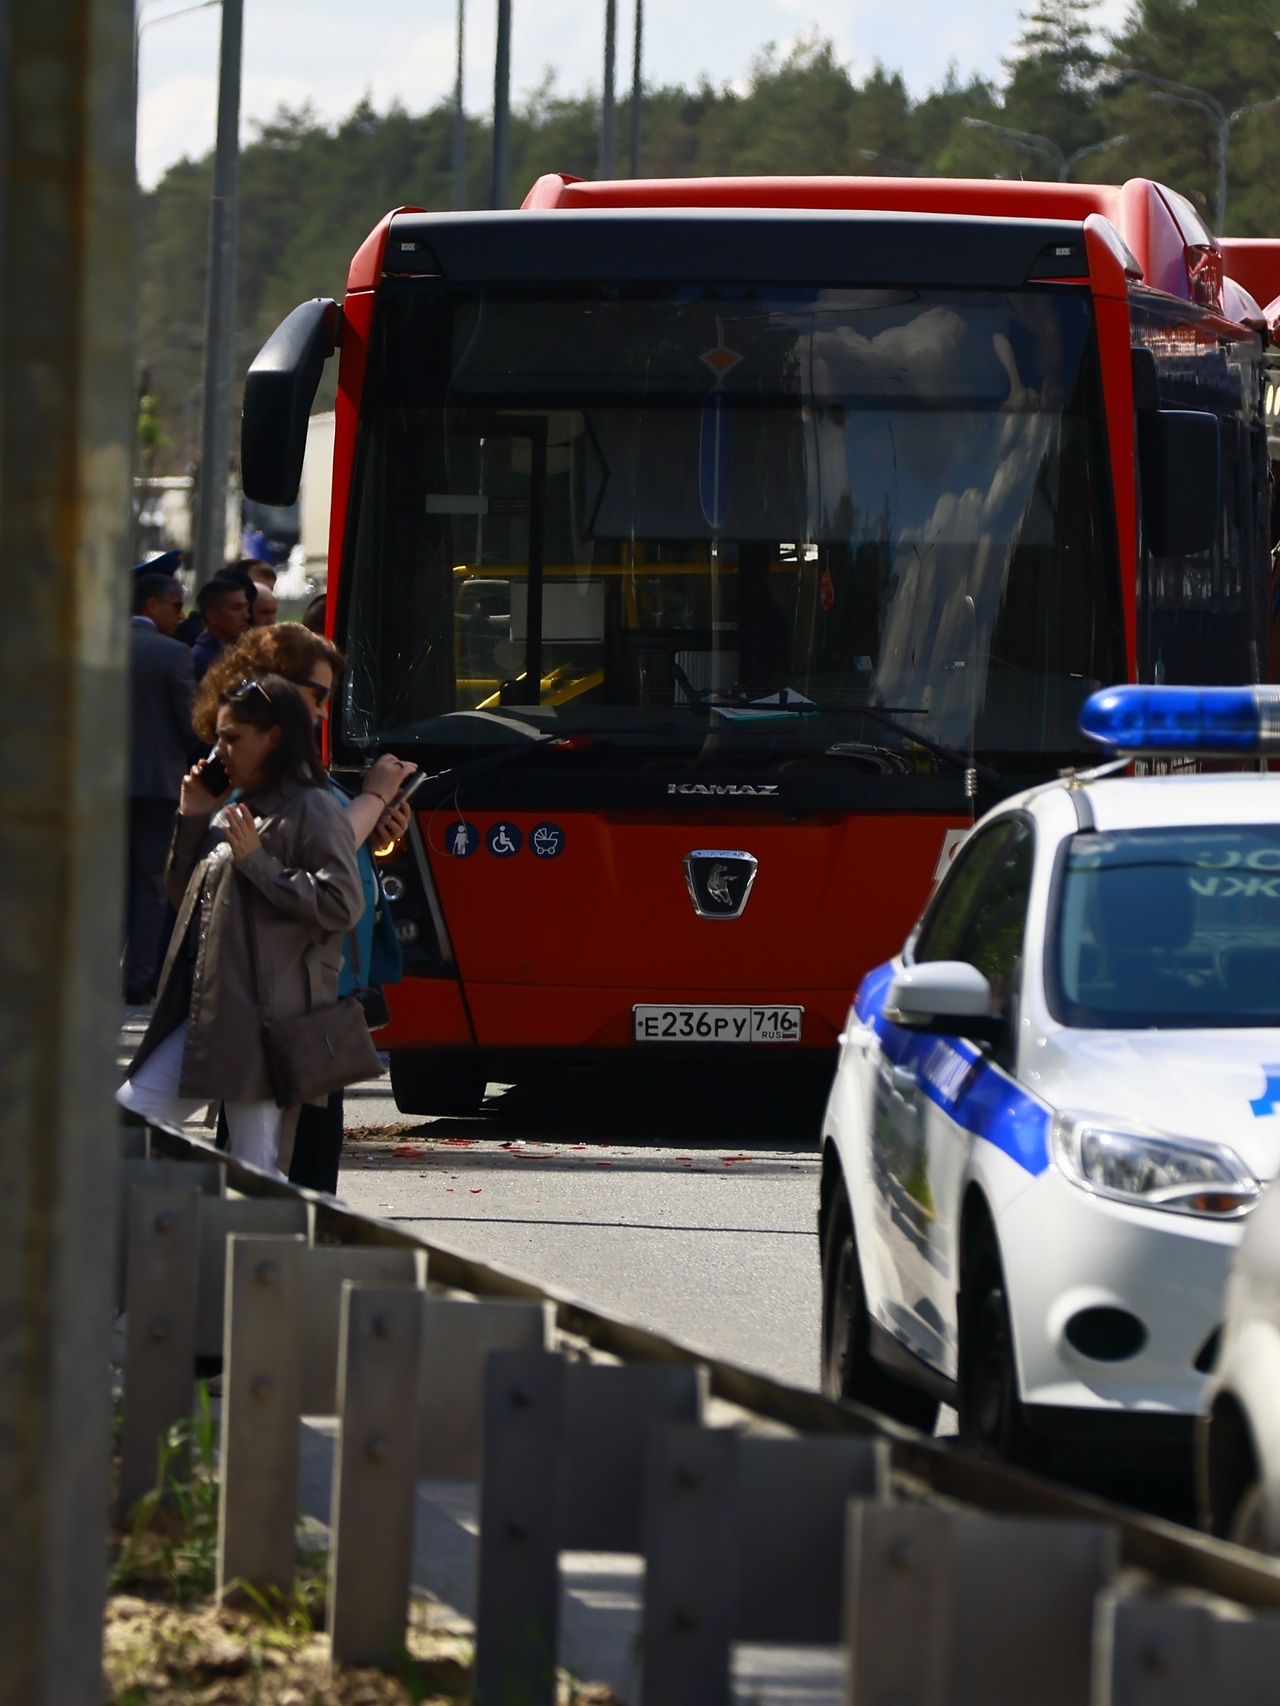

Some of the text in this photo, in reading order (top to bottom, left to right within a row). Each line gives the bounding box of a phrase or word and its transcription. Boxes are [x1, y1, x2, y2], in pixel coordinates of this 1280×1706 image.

[667, 783, 779, 795] KAMAZ
[753, 1011, 793, 1032] 716
[761, 1031, 782, 1039] RUS
